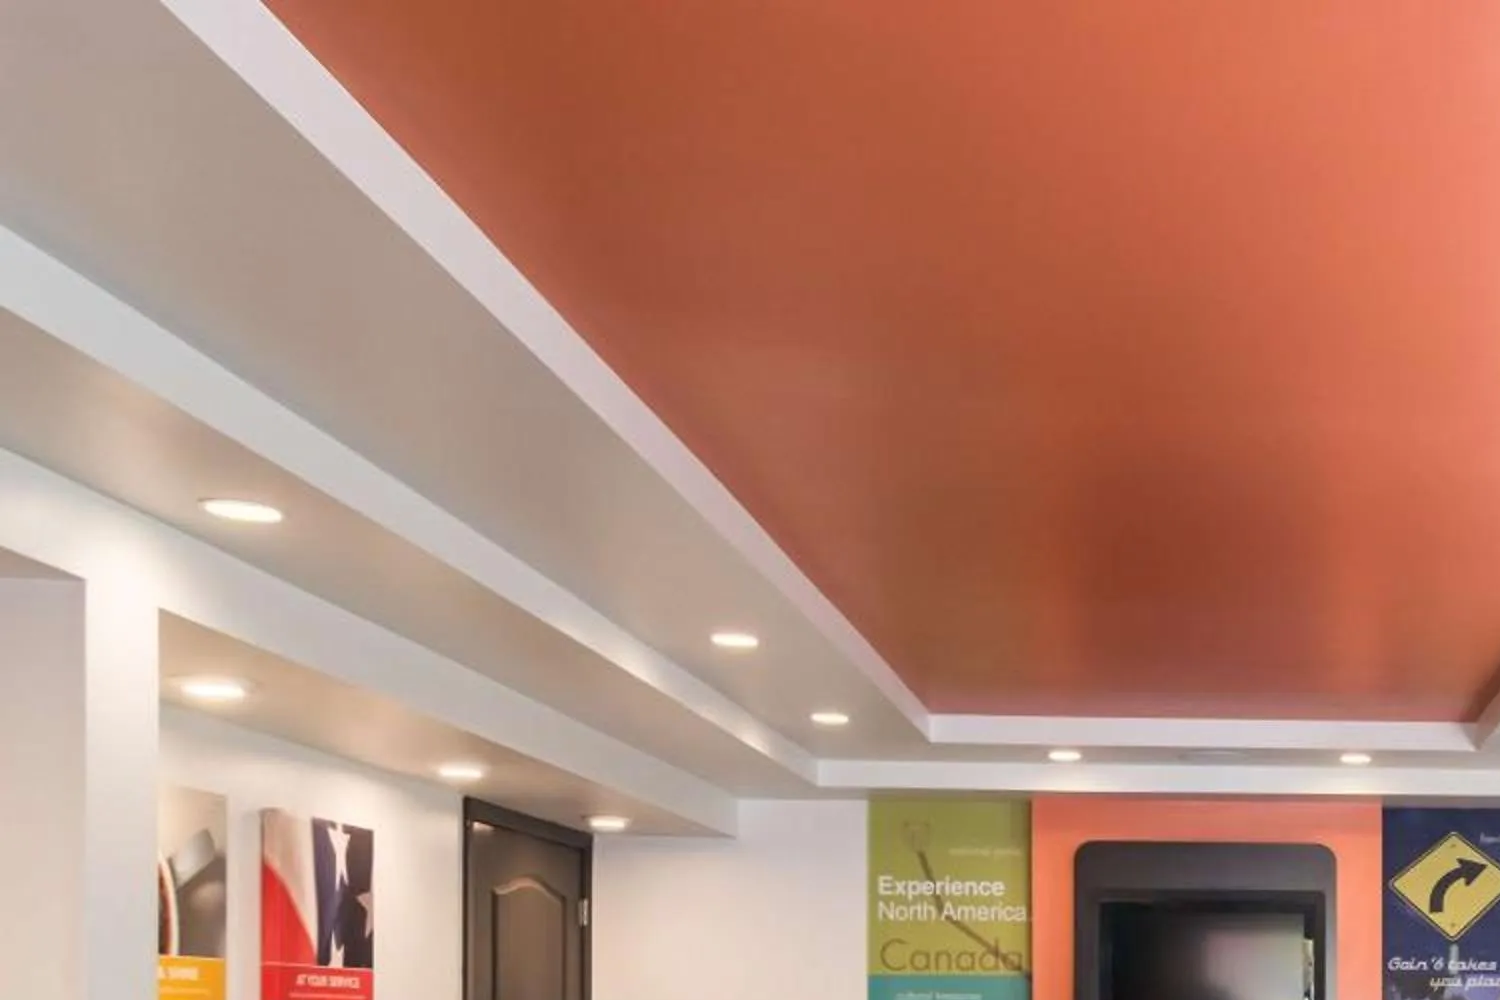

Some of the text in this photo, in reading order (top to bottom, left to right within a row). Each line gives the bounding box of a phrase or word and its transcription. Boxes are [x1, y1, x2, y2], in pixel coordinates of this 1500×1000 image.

[877, 875, 1005, 899] Experience
[878, 900, 936, 921] North
[879, 937, 1022, 972] Canada
[1447, 957, 1498, 971] takes
